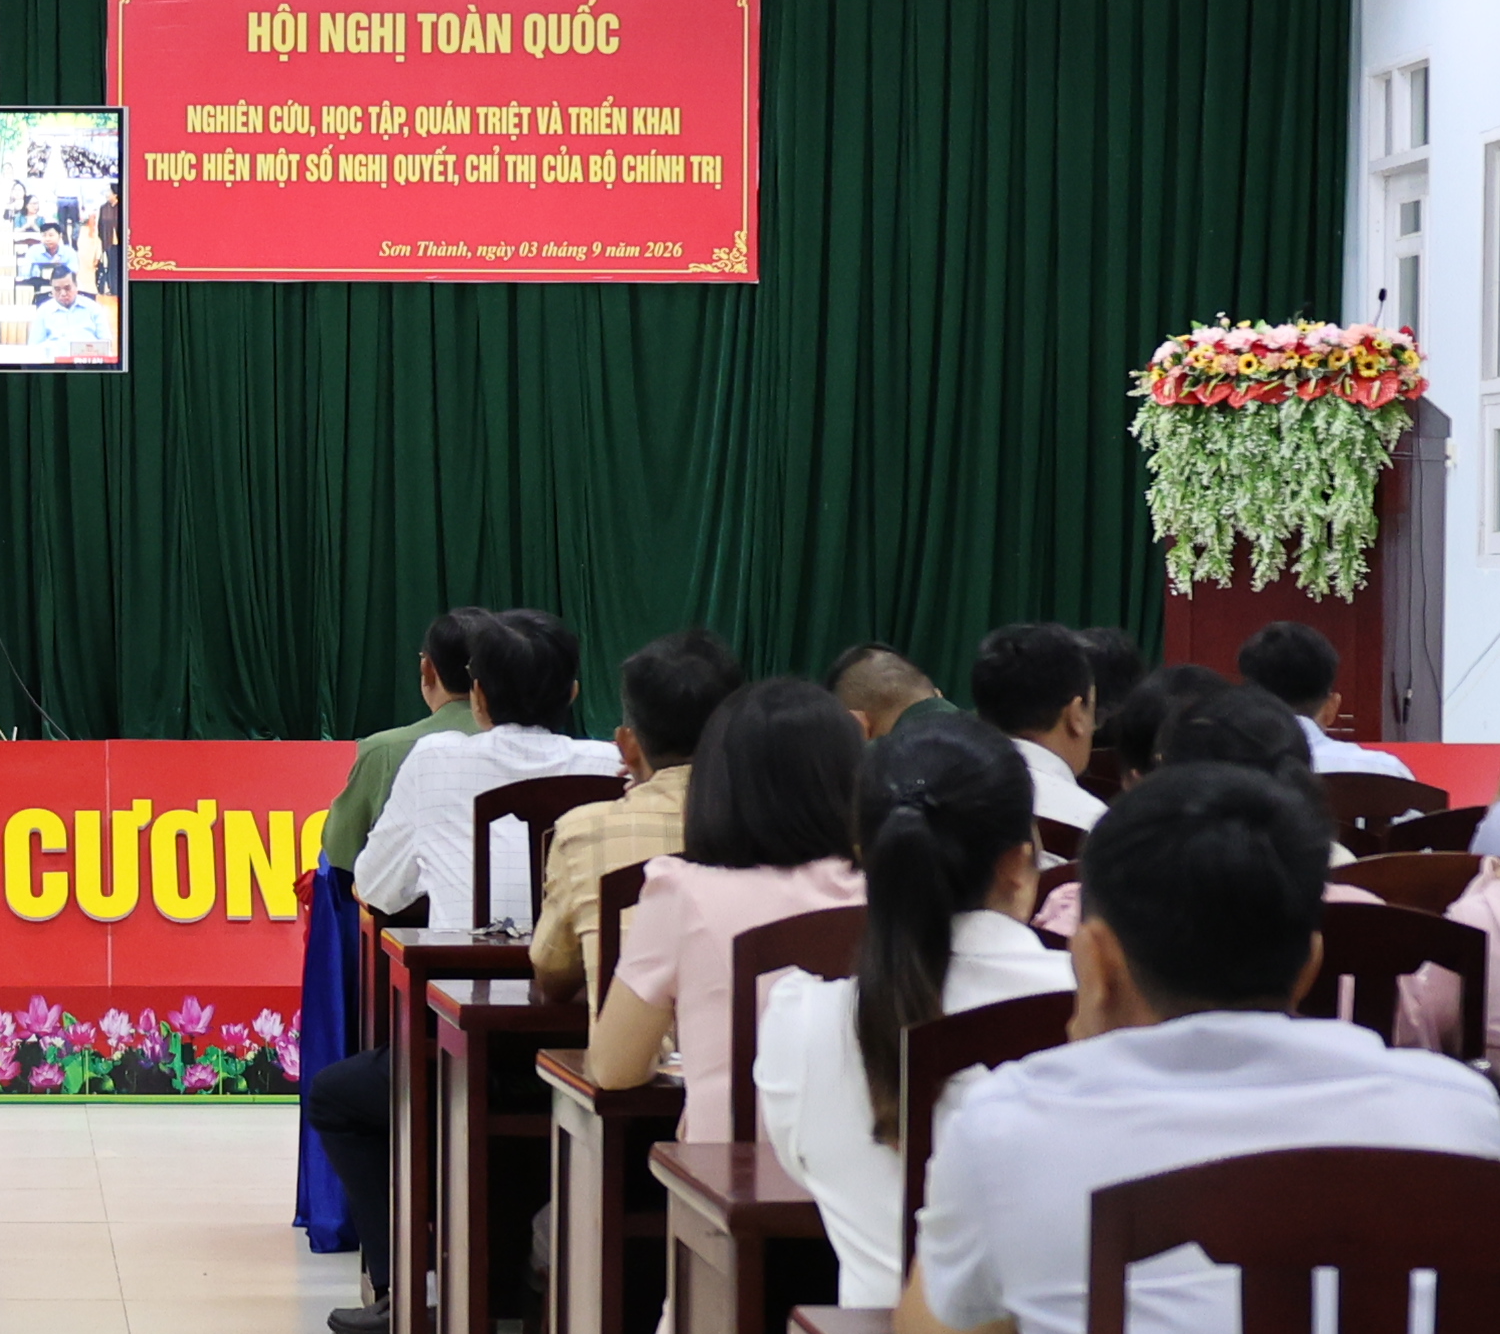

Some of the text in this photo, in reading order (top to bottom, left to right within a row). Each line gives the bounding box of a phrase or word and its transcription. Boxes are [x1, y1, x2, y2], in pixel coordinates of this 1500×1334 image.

[249, 0, 619, 62] HỘI NGHỊ TOÀN QUỐC
[188, 96, 679, 140] NGHIÊN CỨU, HỌC TẬP, QUÁN TRIỆT VÀ TRIỂN KHAI
[145, 144, 721, 189] THỰC HIỆN MỘT SỐ NGHỊ QUYẾT, CHỈ THỊ CỦA BỘ CHÍNH TRỊ
[379, 241, 682, 260] Sơn Thành, ngày 03 tháng 9 năm 2026
[5, 799, 333, 922] CƯƠN
